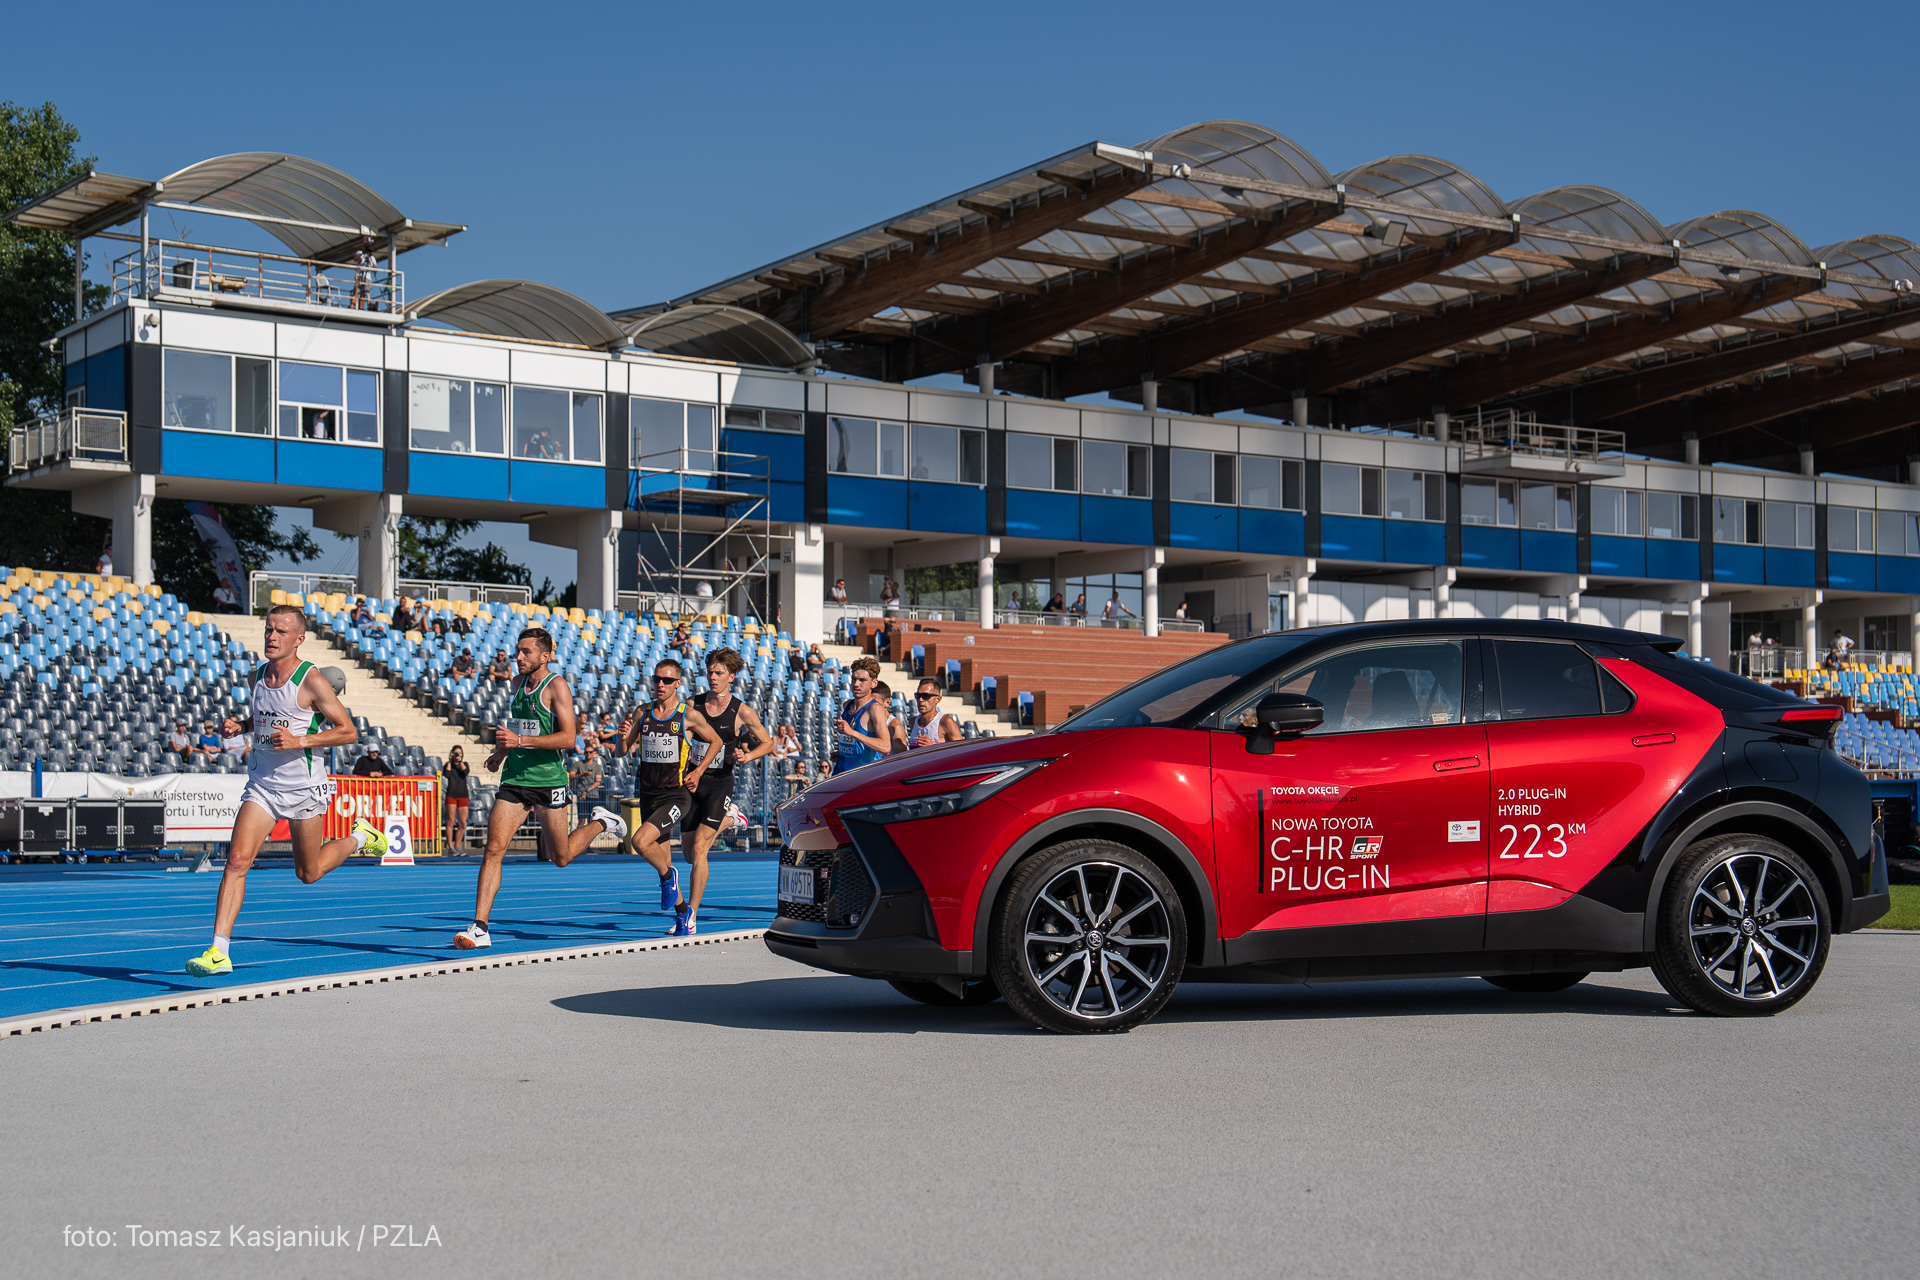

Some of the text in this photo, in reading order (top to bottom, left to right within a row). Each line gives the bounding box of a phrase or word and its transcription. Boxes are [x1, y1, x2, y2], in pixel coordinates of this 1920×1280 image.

[522, 721, 536, 730] 122
[645, 750, 673, 758] BISKUP
[153, 790, 224, 801] Ministerstwo
[315, 783, 328, 797] 19
[552, 790, 565, 802] 21
[1271, 786, 1340, 796] TOYOTA OKĘCIE
[1498, 788, 1567, 800] 2.0 PLUG-IN
[165, 806, 189, 817] ortu
[1498, 804, 1541, 816] HYBRID
[1271, 817, 1374, 831] NOWA TOYOTA
[389, 825, 407, 854] 3
[1499, 823, 1586, 859] 223 KM
[1270, 836, 1344, 861] C-HR
[1353, 843, 1380, 853] GR
[1271, 864, 1390, 891] PLUG-IN
